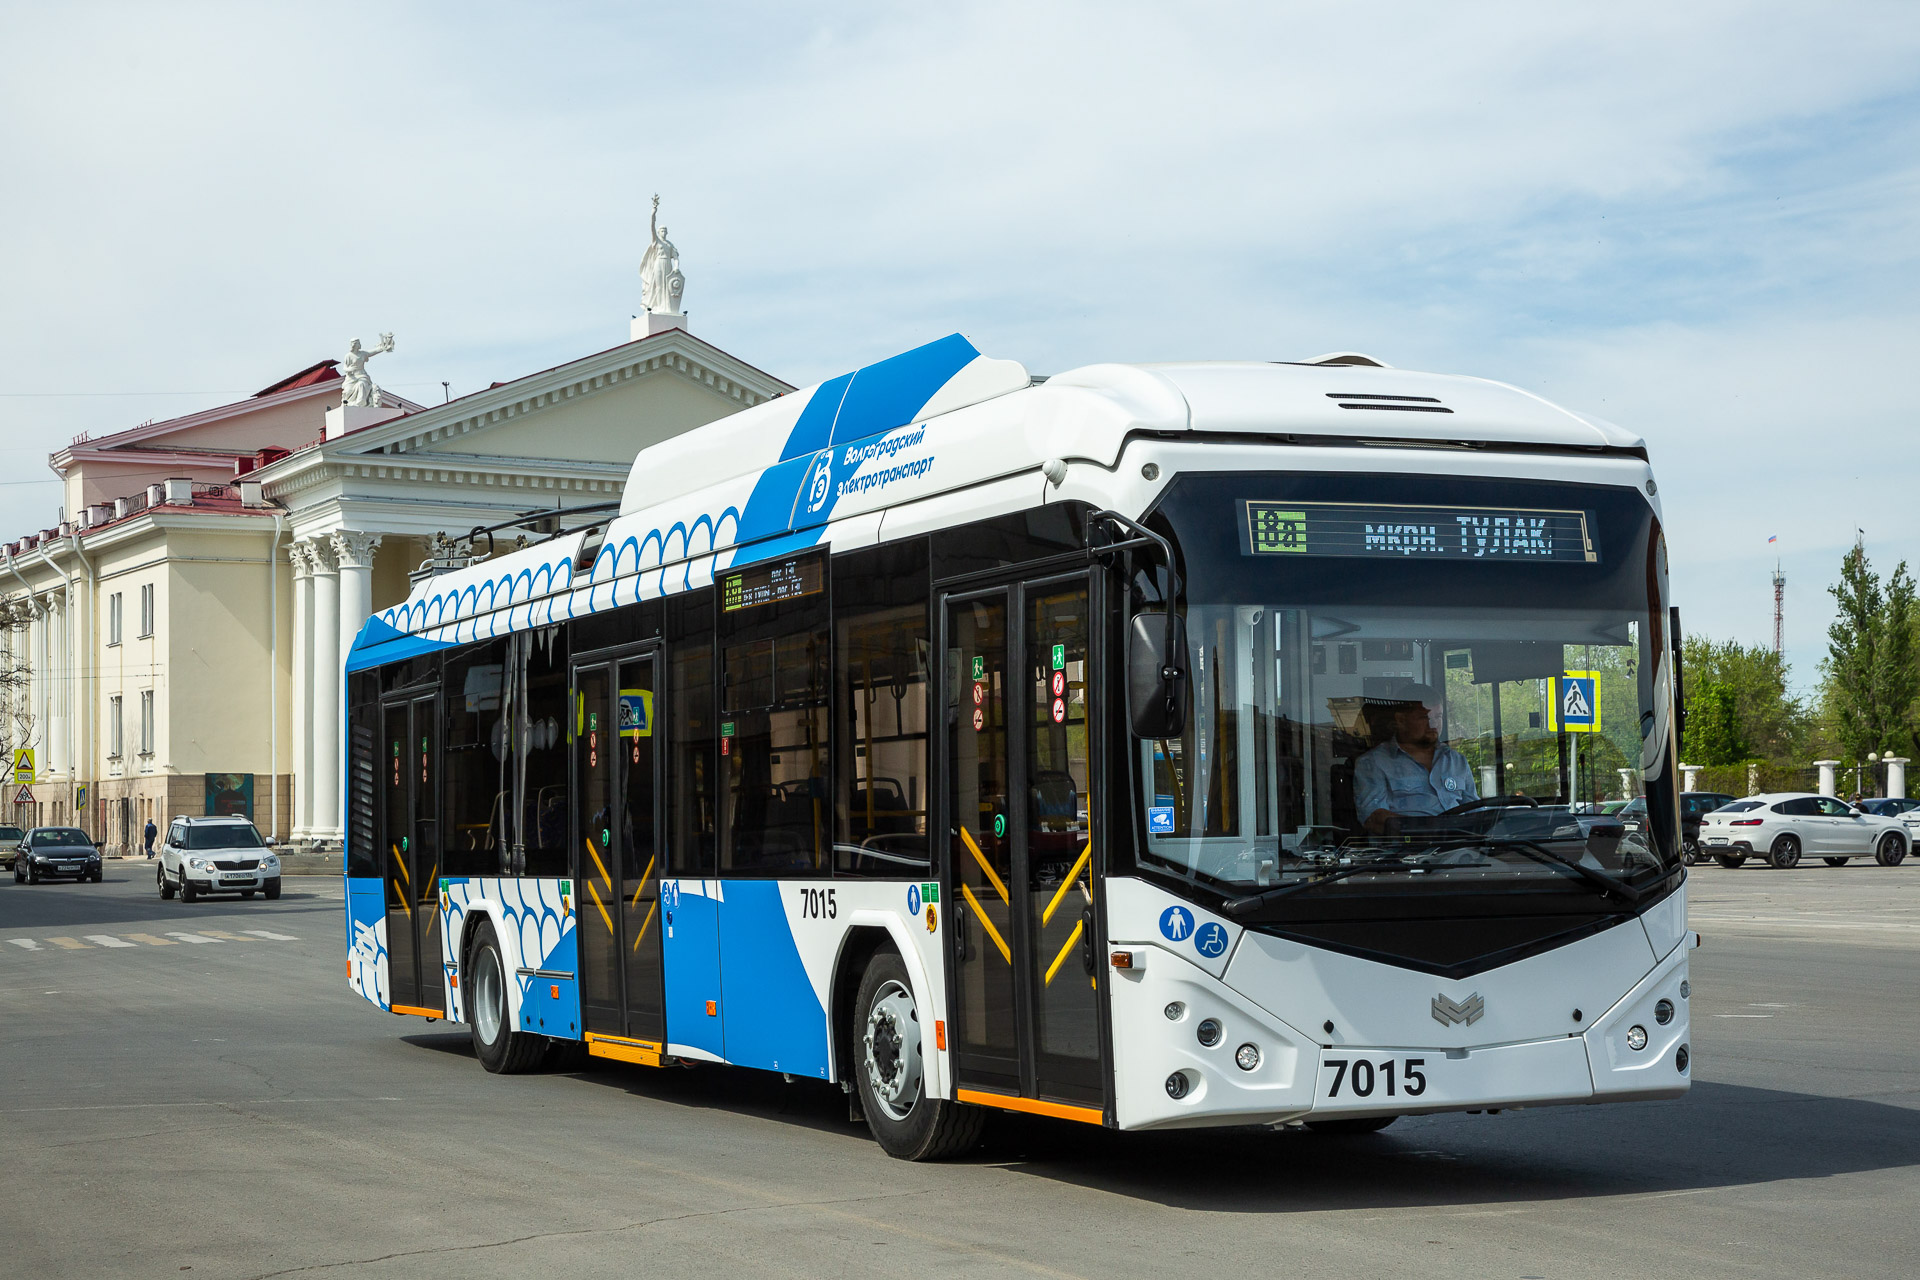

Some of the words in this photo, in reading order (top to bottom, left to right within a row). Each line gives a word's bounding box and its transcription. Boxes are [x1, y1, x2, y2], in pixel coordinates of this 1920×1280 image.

[844, 424, 927, 466] Волгоградский
[836, 456, 935, 497] электротранспорт
[800, 888, 837, 920] 7015
[1323, 1058, 1427, 1098] 7015
